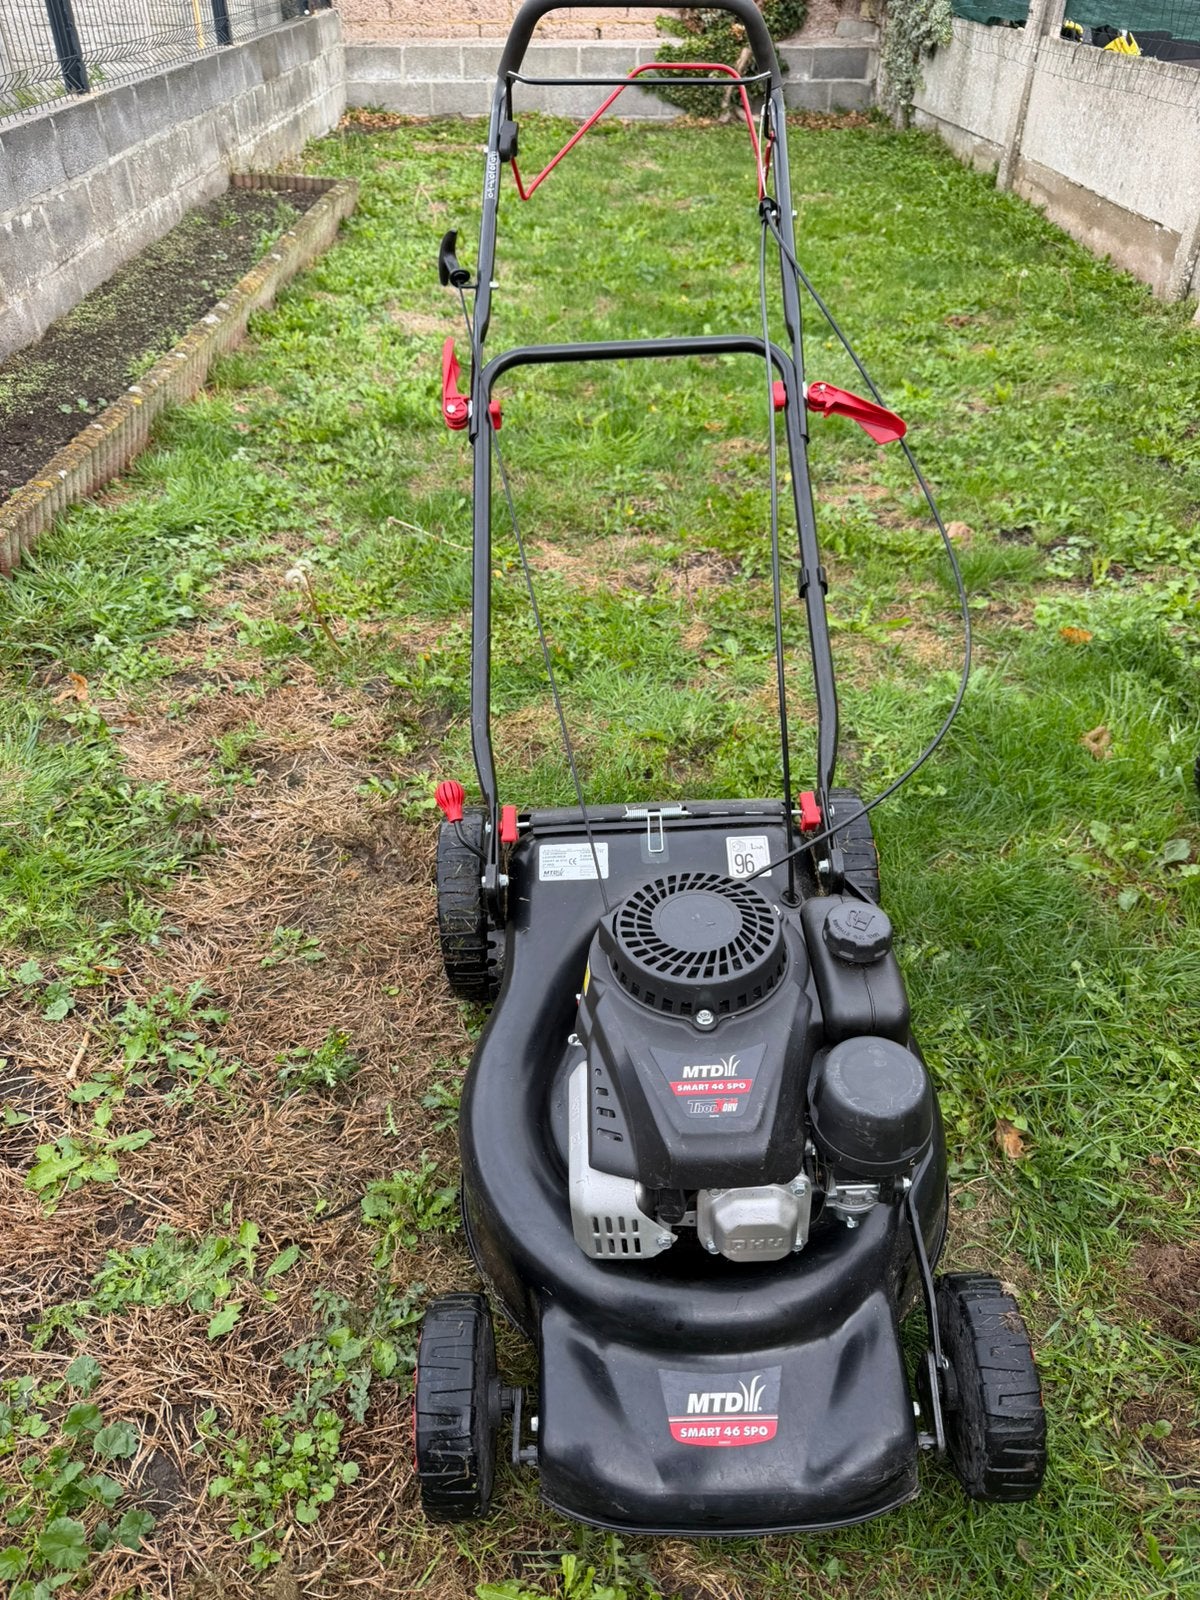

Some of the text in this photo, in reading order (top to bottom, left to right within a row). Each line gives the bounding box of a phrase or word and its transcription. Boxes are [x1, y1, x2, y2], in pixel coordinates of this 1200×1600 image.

[734, 853, 755, 874] 96
[683, 1065, 724, 1078] MTD
[677, 1083, 709, 1092] SMART
[687, 1392, 744, 1413] MTD
[680, 1426, 768, 1438] SMART 46 SPO
